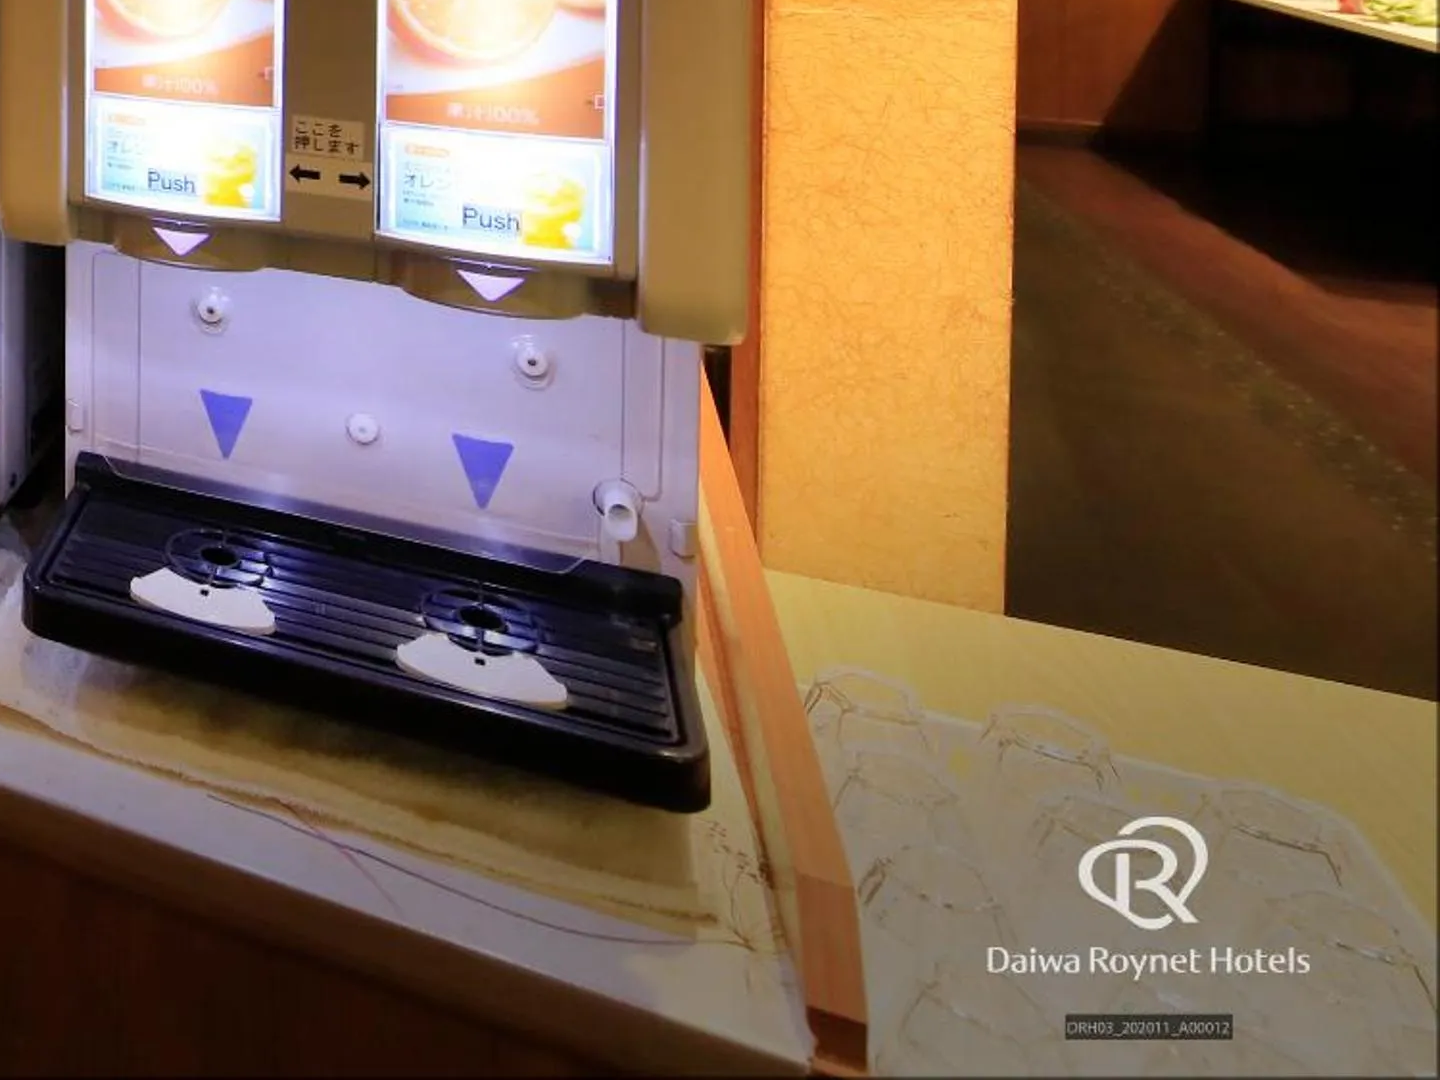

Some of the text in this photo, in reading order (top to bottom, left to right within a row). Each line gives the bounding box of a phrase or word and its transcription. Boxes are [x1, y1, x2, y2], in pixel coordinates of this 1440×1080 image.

[295, 120, 343, 138] ここを
[295, 136, 360, 155] 押します
[147, 169, 195, 193] Push
[463, 206, 520, 231] Push
